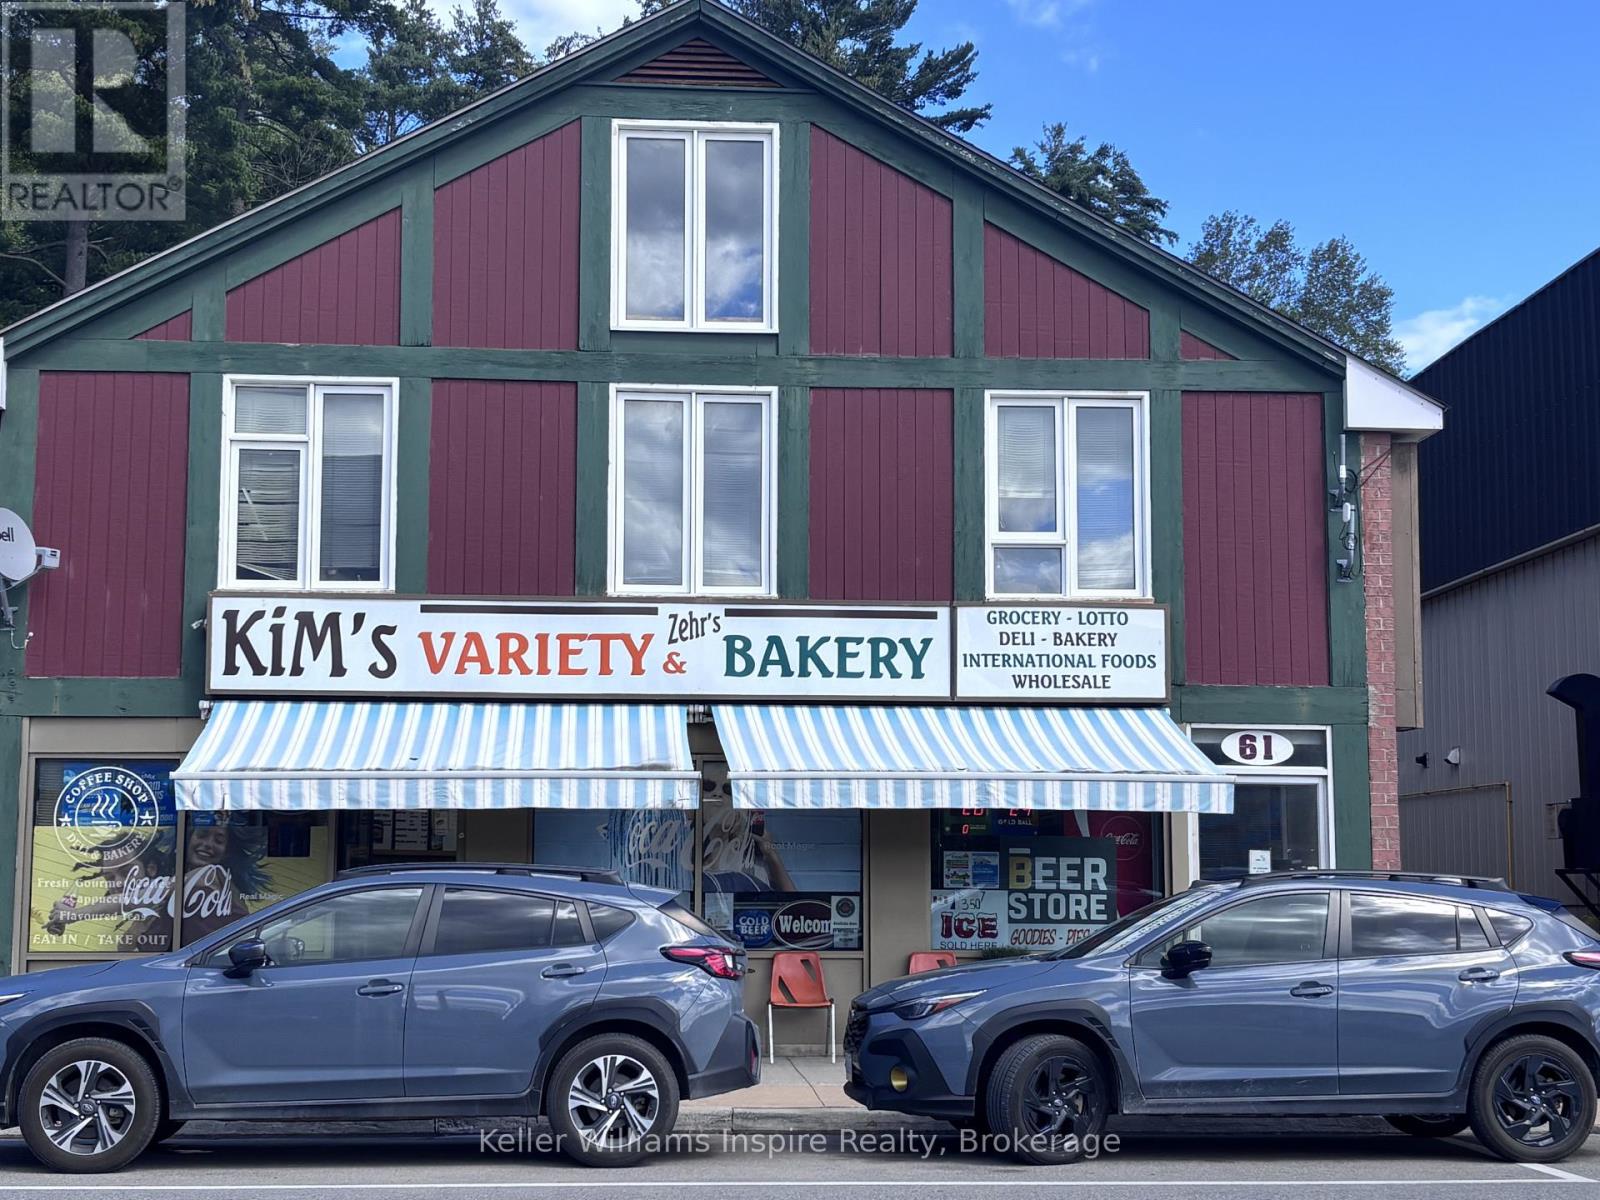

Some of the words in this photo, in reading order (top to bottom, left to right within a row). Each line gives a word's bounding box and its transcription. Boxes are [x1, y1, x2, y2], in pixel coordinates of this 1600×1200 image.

[0, 527, 14, 542] ell
[986, 610, 1061, 625] GROCERY
[1078, 611, 1129, 626] LOTTO
[667, 611, 721, 644] Zehr's
[999, 632, 1035, 646] DELI
[1053, 632, 1118, 647] BAKERY
[417, 631, 655, 675] VARIETY
[662, 651, 688, 674] &
[724, 635, 933, 680] BAKERY
[963, 653, 1096, 668] INTERNATIONAL
[1101, 654, 1157, 669] FOODS
[1012, 674, 1111, 689] WHOLESALE
[1238, 734, 1274, 760] 61
[65, 771, 112, 804] COFFEE
[115, 773, 148, 803] SHOP
[66, 831, 90, 857] DELI
[102, 831, 147, 861] BAKERY
[1008, 856, 1107, 890] BEER
[37, 878, 69, 888] Fresh
[75, 878, 126, 888] Gourme
[1008, 893, 1107, 920] STORE
[59, 910, 118, 921] Flavoured
[739, 915, 769, 925] COLD
[740, 925, 769, 935] BEER
[779, 915, 833, 934] Welcom
[941, 911, 998, 939] ICE
[32, 934, 57, 945] EAT
[61, 934, 78, 945] IN
[97, 934, 133, 945] TAKE
[137, 934, 168, 945] OUT
[1011, 928, 1056, 945] GOODIES
[940, 941, 968, 950] SOLD
